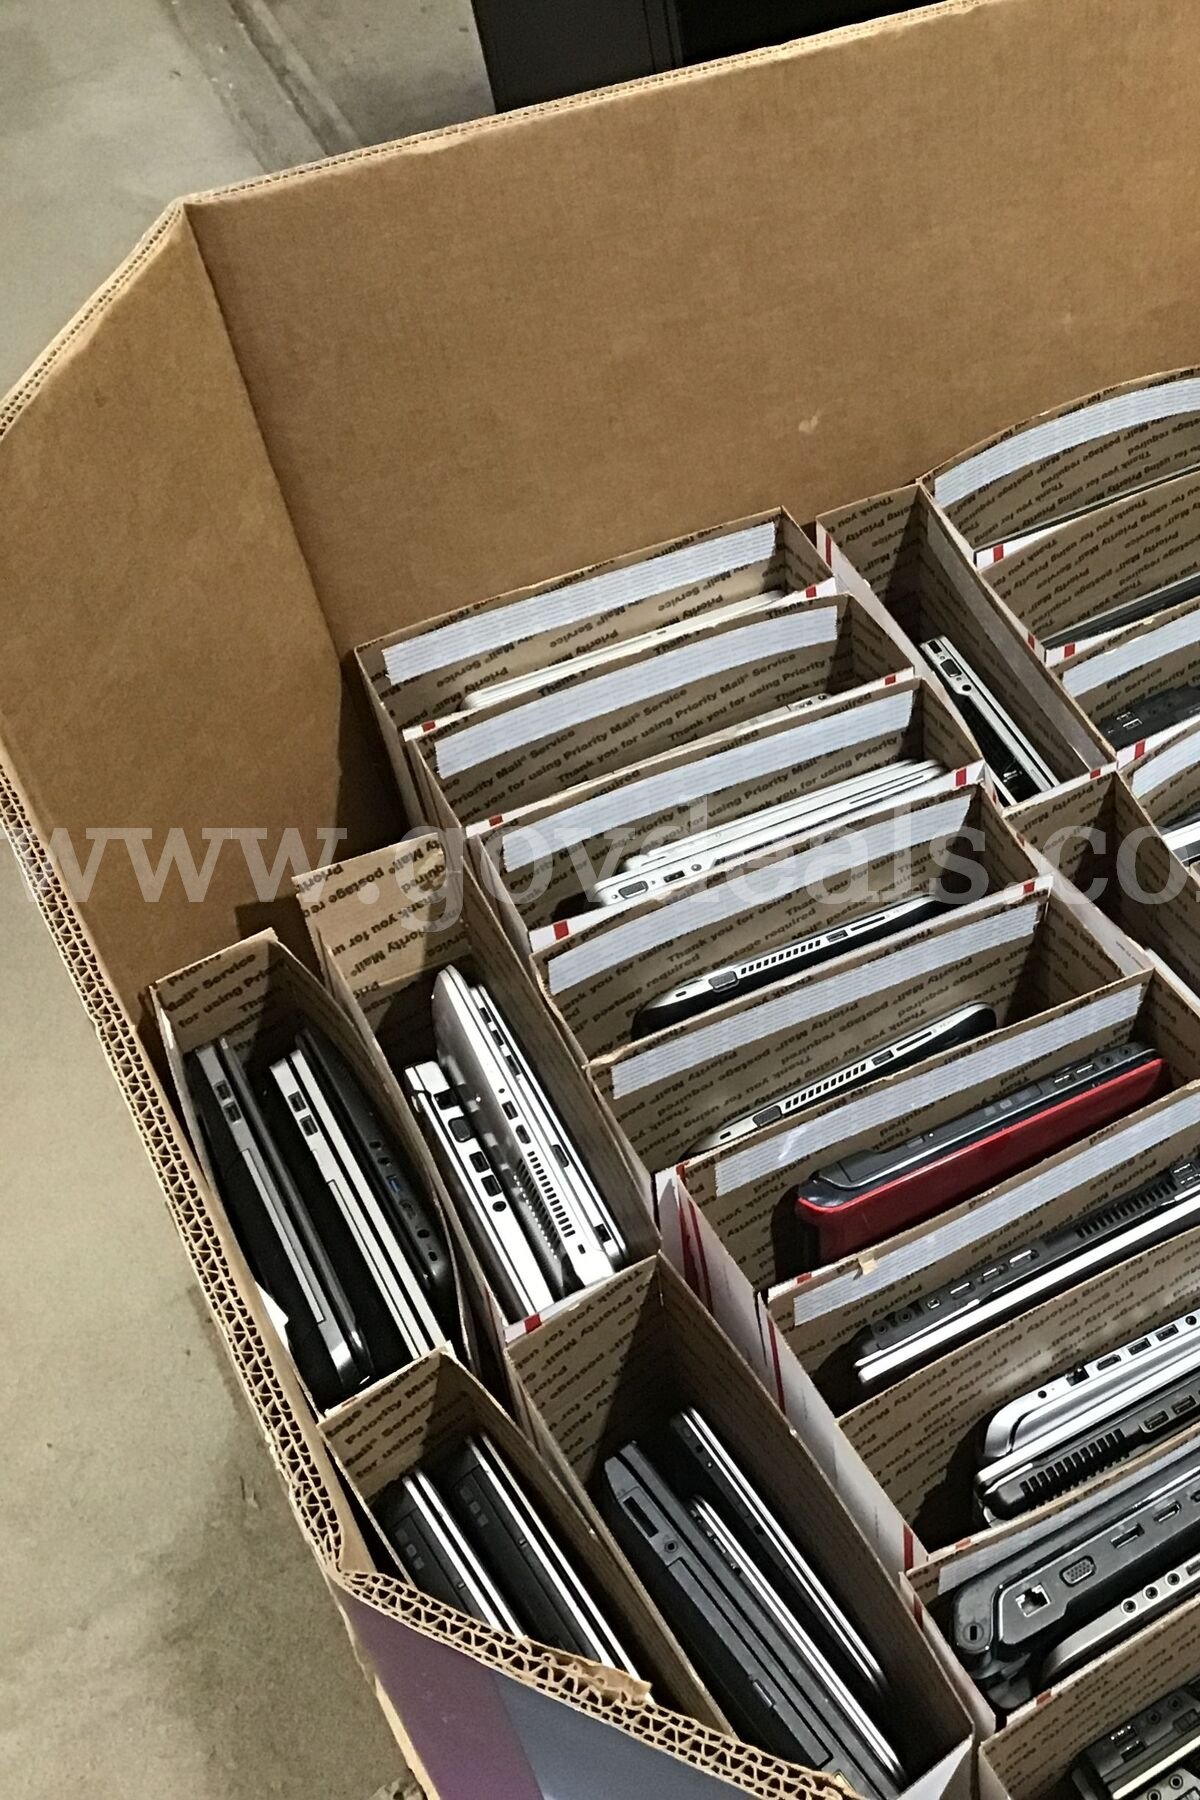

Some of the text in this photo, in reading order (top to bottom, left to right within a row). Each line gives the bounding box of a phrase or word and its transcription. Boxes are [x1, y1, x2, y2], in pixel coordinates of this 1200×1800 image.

[1127, 431, 1169, 456] required
[1174, 450, 1187, 460] for
[1041, 437, 1121, 482] postage required
[1144, 457, 1171, 474] using
[1000, 470, 1033, 497] postage
[1022, 451, 1151, 527] Thank you for using Priority
[1107, 472, 1142, 495] Priority
[838, 497, 892, 527] Thank you
[1001, 482, 1064, 524] Thank you for
[1140, 503, 1168, 521] using
[1171, 494, 1184, 504] for
[845, 520, 884, 542] Priority
[1013, 499, 1147, 589] Thank you for using Priority
[1102, 521, 1138, 545] Priority
[1124, 525, 1161, 548] Service
[993, 540, 1058, 588] Thank you for
[1037, 566, 1072, 589] Service
[1074, 531, 1179, 596] Priority postage
[1119, 559, 1160, 584] required
[1180, 561, 1197, 574] you
[1054, 568, 1090, 594] Priority
[657, 586, 700, 612] Service
[682, 595, 723, 621] Priority
[1093, 581, 1142, 614] Thank you
[549, 622, 593, 649] Service
[576, 629, 619, 657] Priority
[436, 659, 481, 688] Service
[464, 666, 509, 694] Priority
[752, 654, 796, 678] Service
[642, 688, 687, 716] Service
[668, 656, 826, 742] Thank you for using Priority
[675, 691, 717, 719] Priority
[641, 715, 673, 741] using
[530, 729, 575, 759] Service
[563, 727, 607, 761] Priority
[855, 736, 898, 759] Priority
[558, 735, 638, 783] Thank you for
[450, 775, 494, 808] Priority
[484, 757, 562, 813] you for using
[744, 774, 789, 800] Priority
[776, 760, 853, 806] you for using
[709, 798, 742, 818] using
[1051, 786, 1093, 813] Priority
[328, 868, 384, 904] postage
[785, 879, 849, 916] Thank you
[371, 913, 398, 934] you
[765, 907, 817, 939] required
[348, 931, 369, 948] for
[668, 913, 755, 962] Thank you for
[203, 954, 256, 990] Service
[590, 962, 634, 993] you for
[647, 954, 700, 987] required
[897, 954, 1000, 1017] postage required
[179, 986, 242, 1028] for using
[593, 988, 642, 1023] postage
[781, 958, 972, 1064] Priority postage required
[804, 1009, 927, 1078] Thank you for using
[657, 1048, 770, 1117] postage required
[683, 1057, 811, 1129] Thank you for using
[567, 1304, 594, 1327] you
[580, 1295, 632, 1337] Priority
[543, 1330, 564, 1347] for
